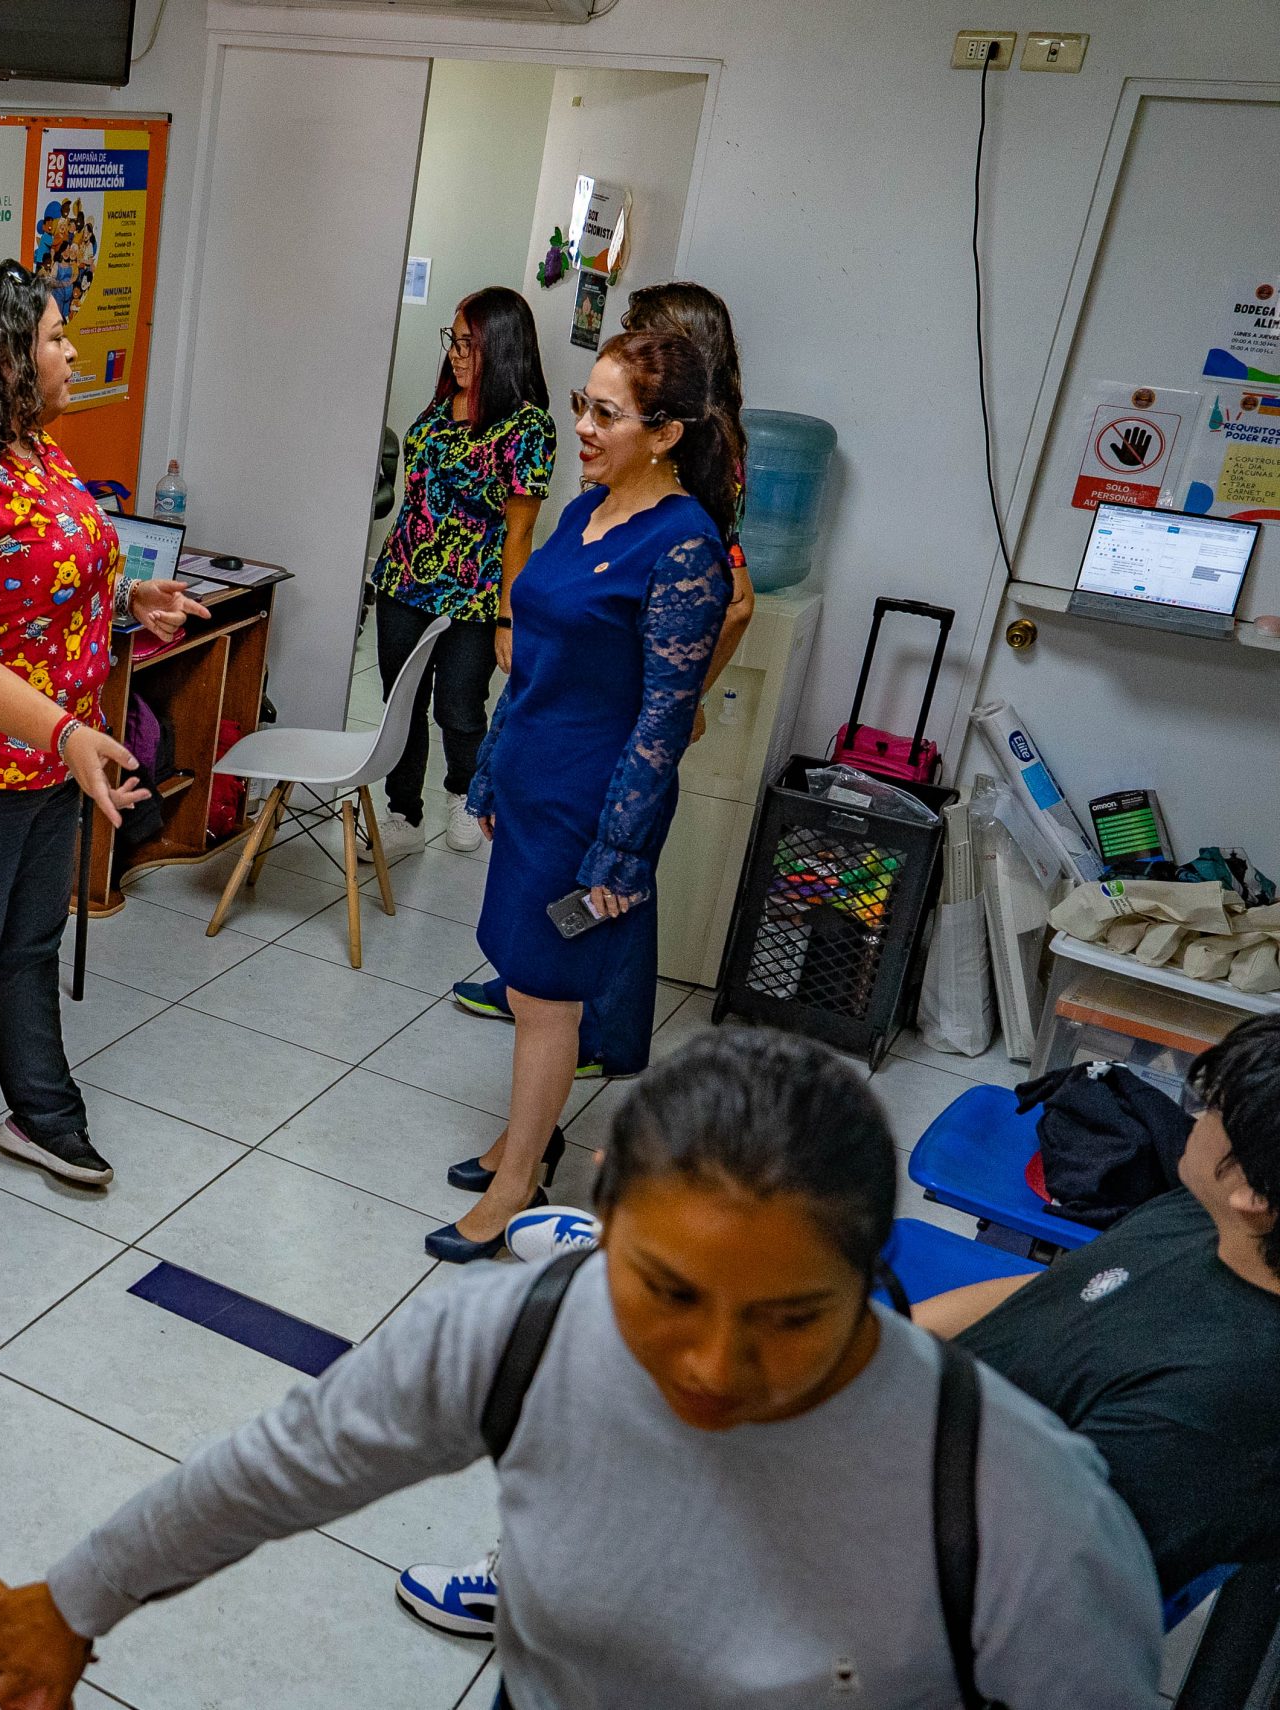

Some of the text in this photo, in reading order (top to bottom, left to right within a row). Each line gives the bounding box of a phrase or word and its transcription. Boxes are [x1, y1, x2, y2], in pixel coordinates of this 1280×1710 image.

[49, 154, 65, 170] 20
[68, 151, 107, 162] CAMPAÑA DE
[68, 162, 124, 175] VACUNACIÓN E
[47, 171, 63, 187] 26
[67, 175, 124, 188] INMUNIZACIÓN
[4, 196, 12, 206] EL
[1234, 304, 1275, 316] BODEGA
[1254, 318, 1280, 329] ALIM
[1224, 422, 1280, 436] REQUISITOS
[1225, 431, 1280, 444] PODER RET
[1235, 456, 1280, 465] CONTROLE
[1233, 469, 1273, 477] VACUNAS
[1091, 491, 1137, 504] PERSONAL
[1228, 488, 1262, 496] CARNET
[1227, 494, 1266, 503] CONTROL
[1013, 735, 1030, 758] Elite
